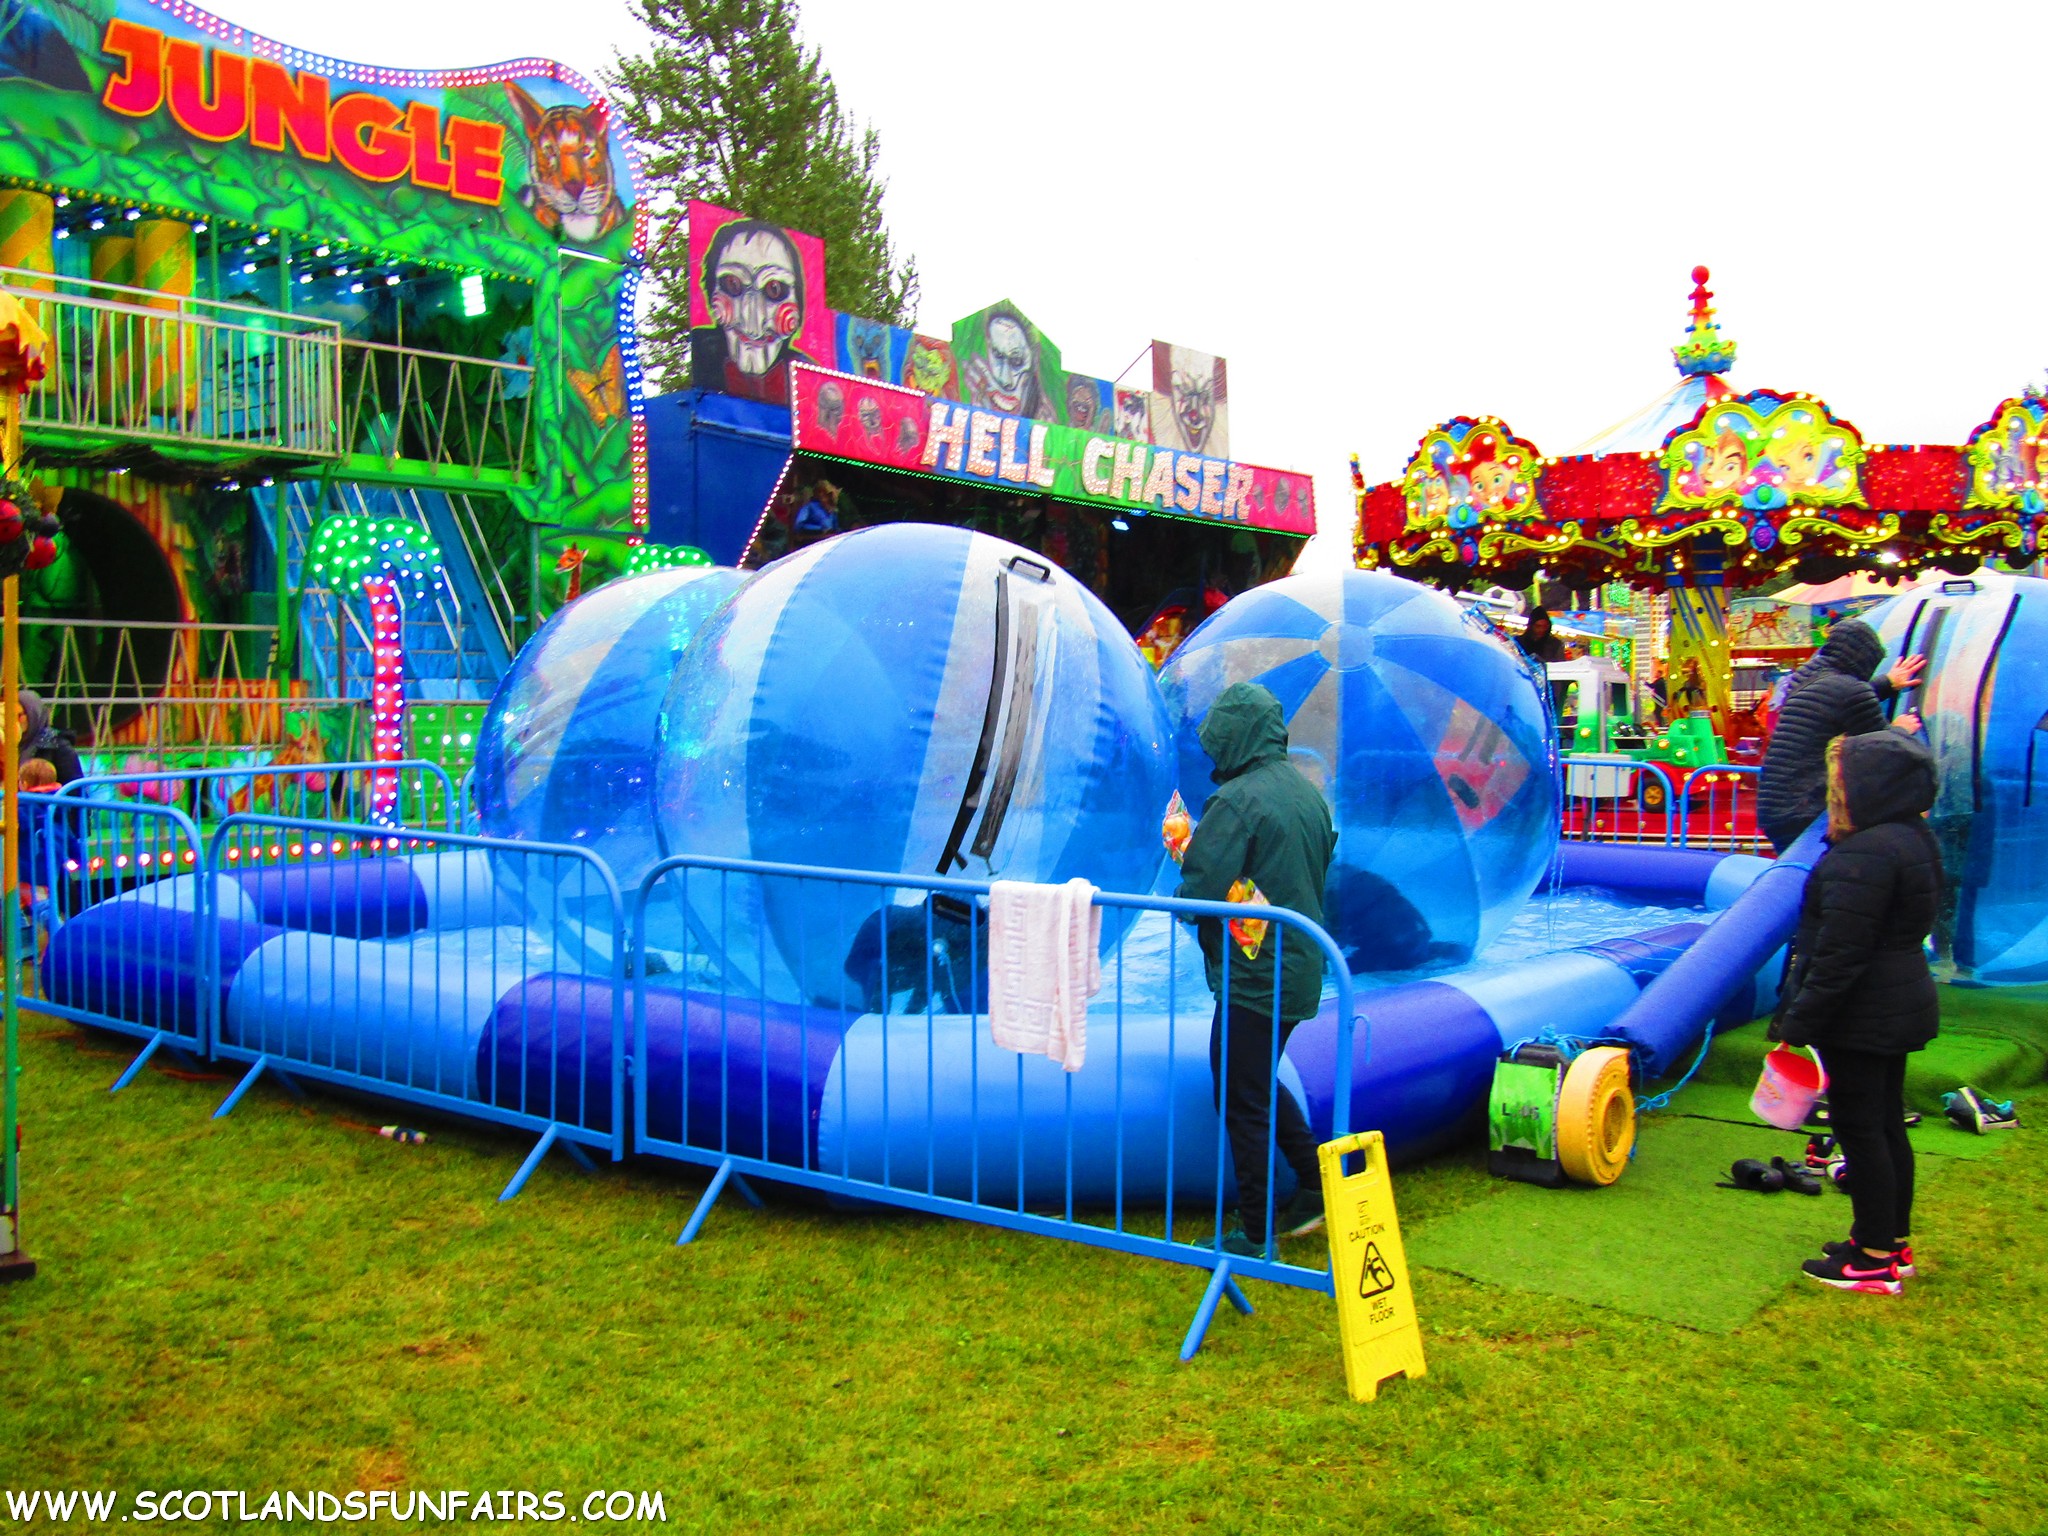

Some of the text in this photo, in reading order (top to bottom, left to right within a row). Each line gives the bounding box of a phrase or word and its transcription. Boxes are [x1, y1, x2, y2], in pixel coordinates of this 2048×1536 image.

[102, 17, 506, 206] JUNGLE
[920, 401, 1254, 520] HELL CHASER
[1349, 1224, 1385, 1242] CAUTION
[1371, 1297, 1387, 1311] WET
[1369, 1306, 1396, 1326] FLOOR
